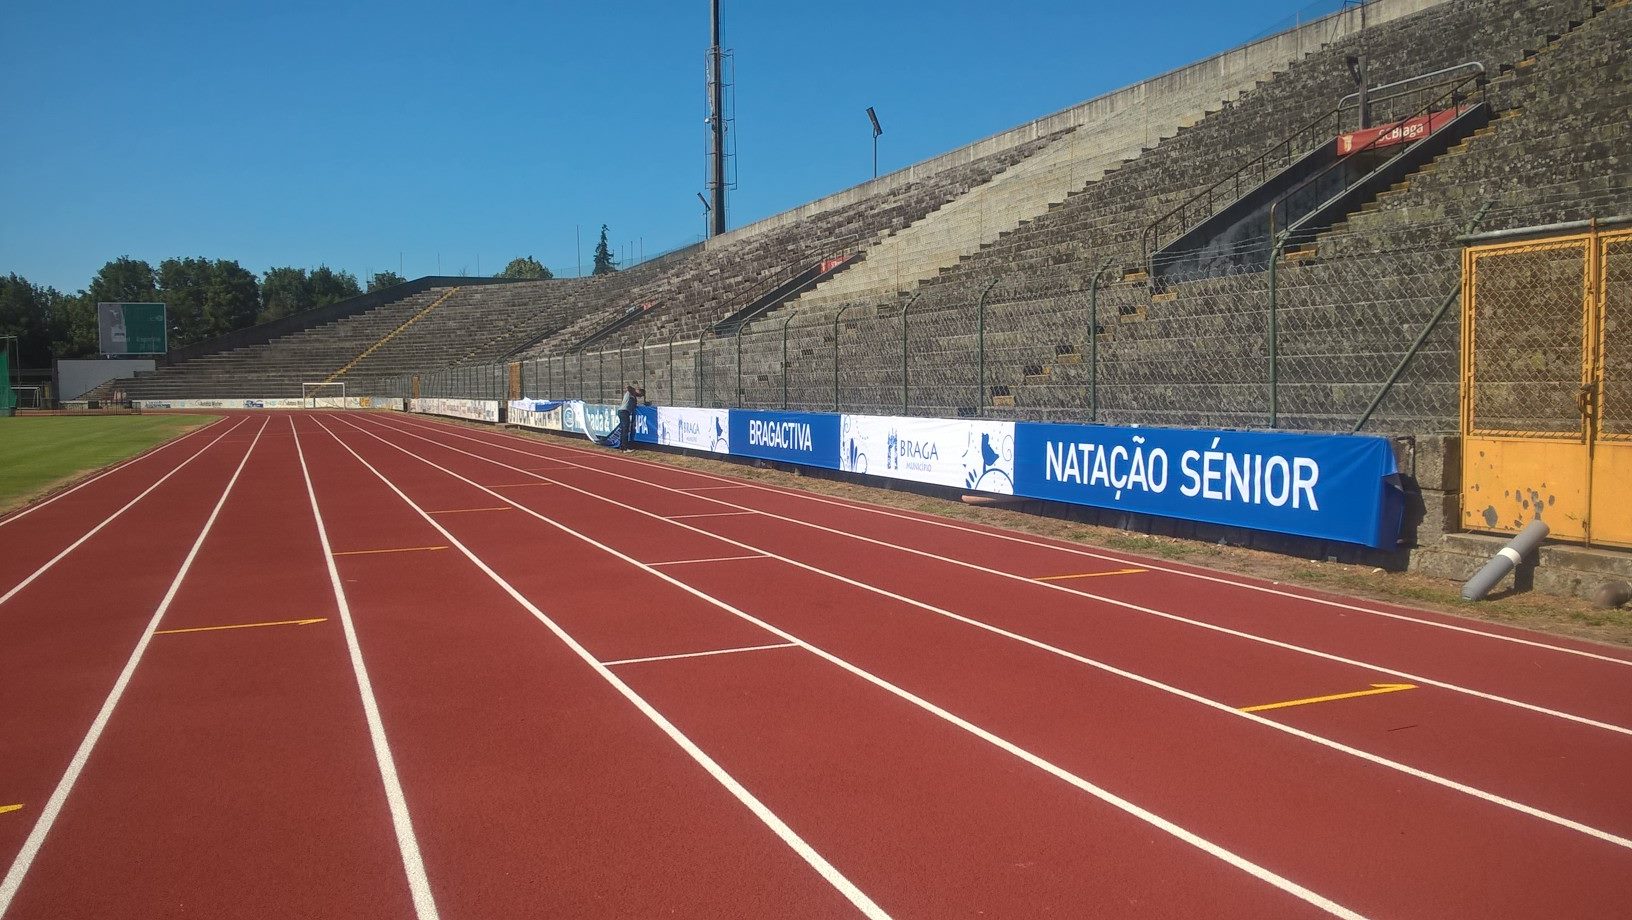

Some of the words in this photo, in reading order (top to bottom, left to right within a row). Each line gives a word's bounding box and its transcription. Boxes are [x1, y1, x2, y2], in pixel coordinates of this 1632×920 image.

[749, 420, 813, 452] BRAGACTIVA
[900, 440, 939, 461] BRAGA
[1045, 436, 1168, 501] NATAÇÃO
[1180, 437, 1319, 512] SÉNIOR
